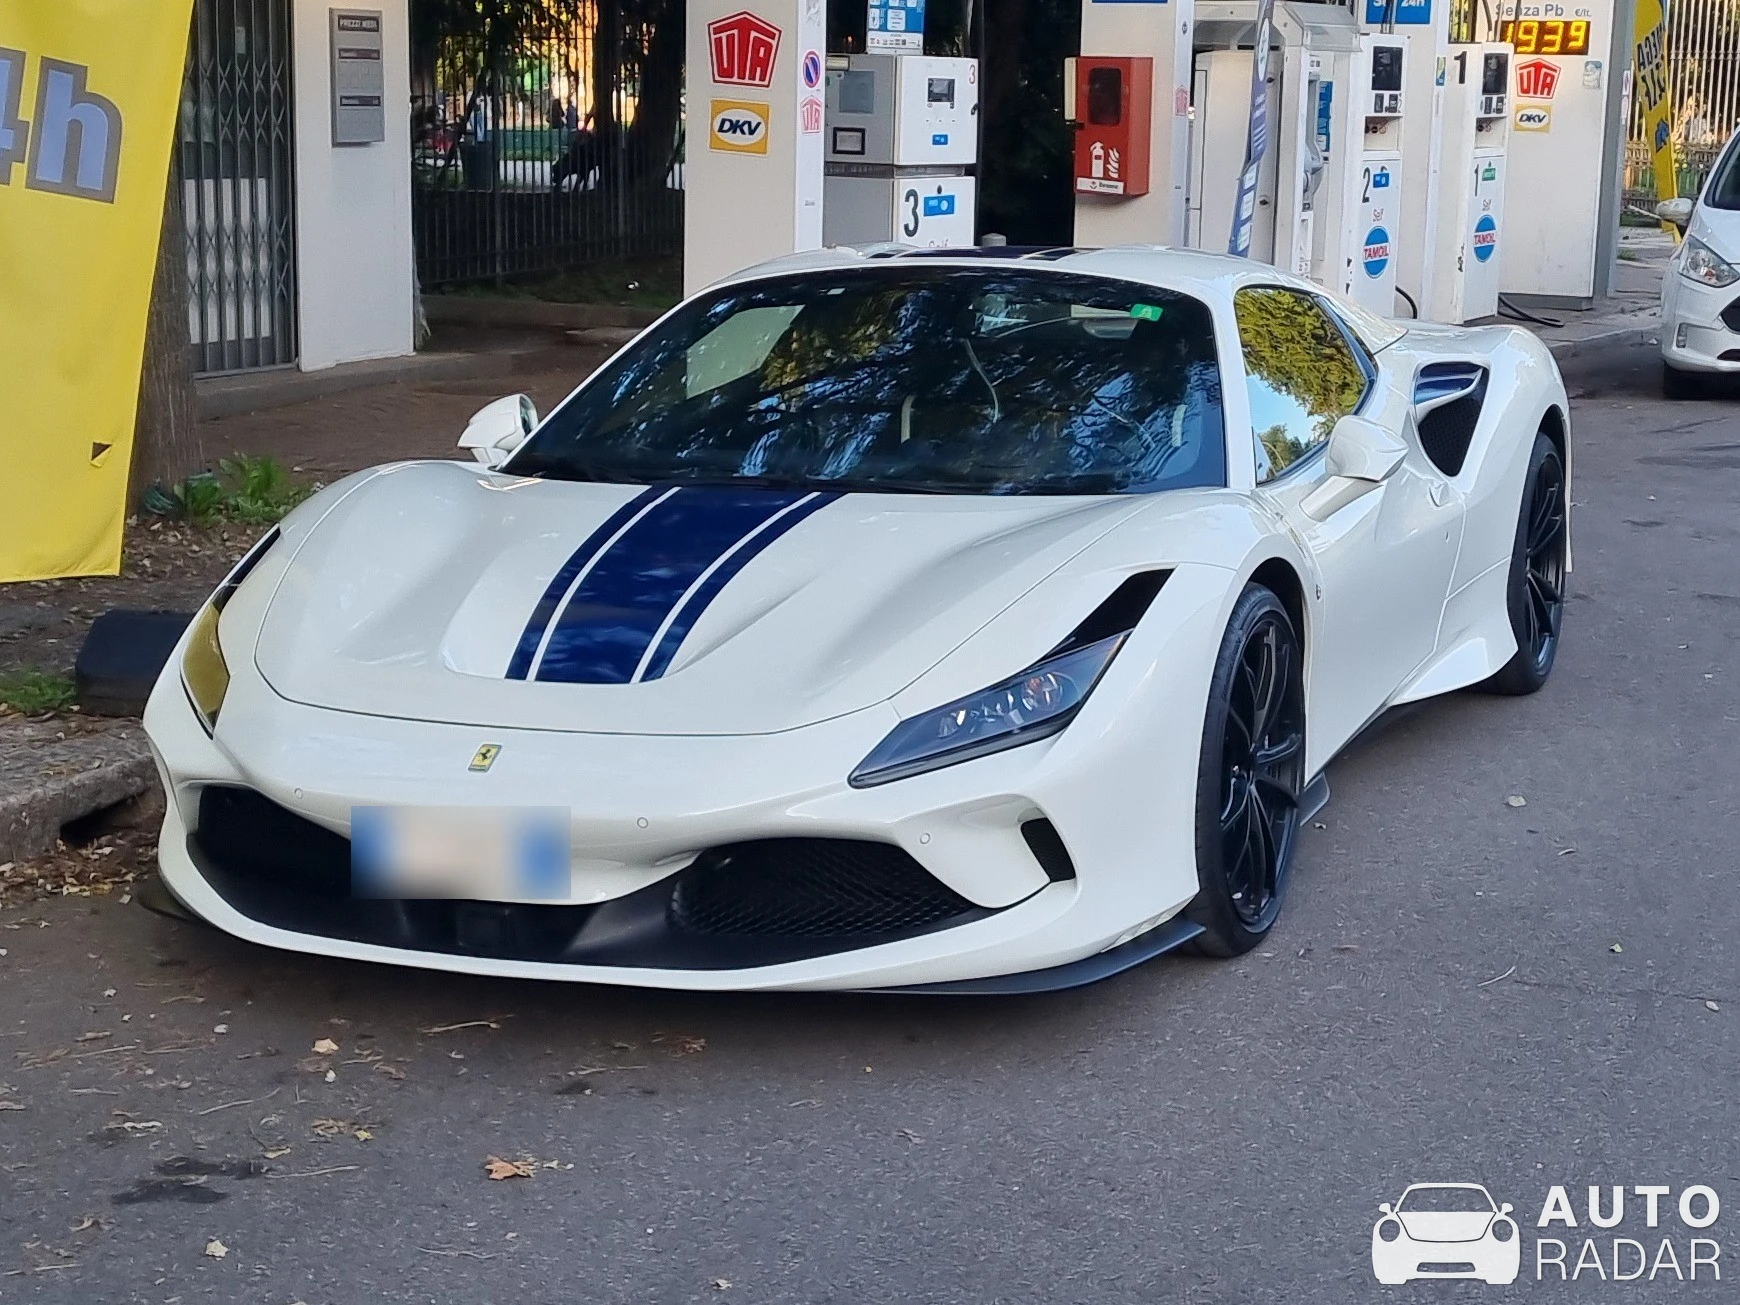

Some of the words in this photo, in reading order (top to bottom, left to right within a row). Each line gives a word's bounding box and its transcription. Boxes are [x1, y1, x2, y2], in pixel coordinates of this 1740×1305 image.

[1544, 3, 1565, 17] Pb
[711, 16, 777, 82] UTA
[968, 64, 976, 84] 3
[1453, 50, 1468, 84] 1
[1518, 61, 1558, 96] UTA
[717, 117, 762, 136] DKV
[1519, 113, 1547, 123] DKV
[1361, 166, 1371, 203] 2
[1473, 163, 1480, 197] 1
[903, 188, 919, 237] 3
[1363, 246, 1390, 260] TAMOIL
